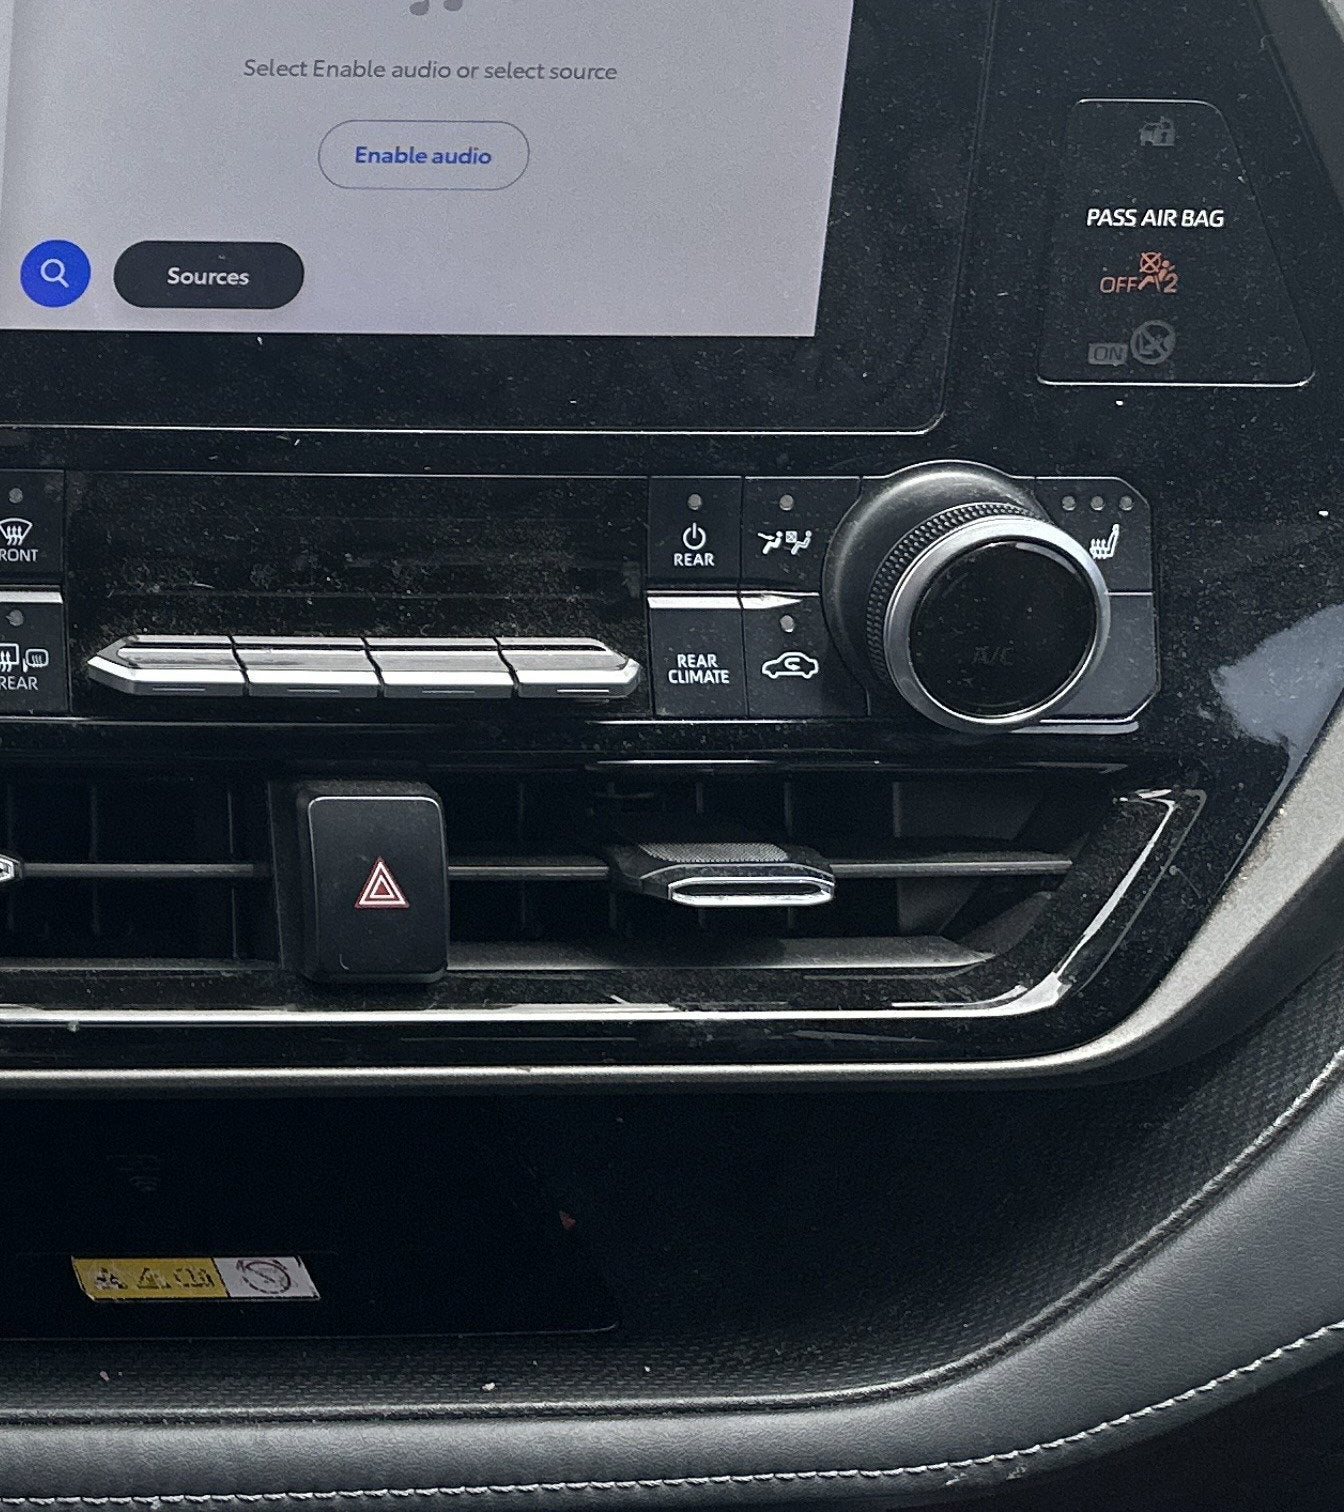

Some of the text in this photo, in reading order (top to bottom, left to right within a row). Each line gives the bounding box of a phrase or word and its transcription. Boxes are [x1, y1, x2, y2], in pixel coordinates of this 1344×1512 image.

[243, 58, 619, 81] Select Enable audio or select source
[354, 145, 493, 165] Enable audio
[1086, 208, 1225, 228] PASS AIR BAG
[167, 266, 250, 286] Sources
[1100, 275, 1140, 293] OFF
[1163, 272, 1179, 294] 2
[1093, 345, 1125, 362] ON
[673, 552, 715, 567] REAR
[676, 653, 719, 669] REAR
[667, 668, 731, 684] CLIMATE
